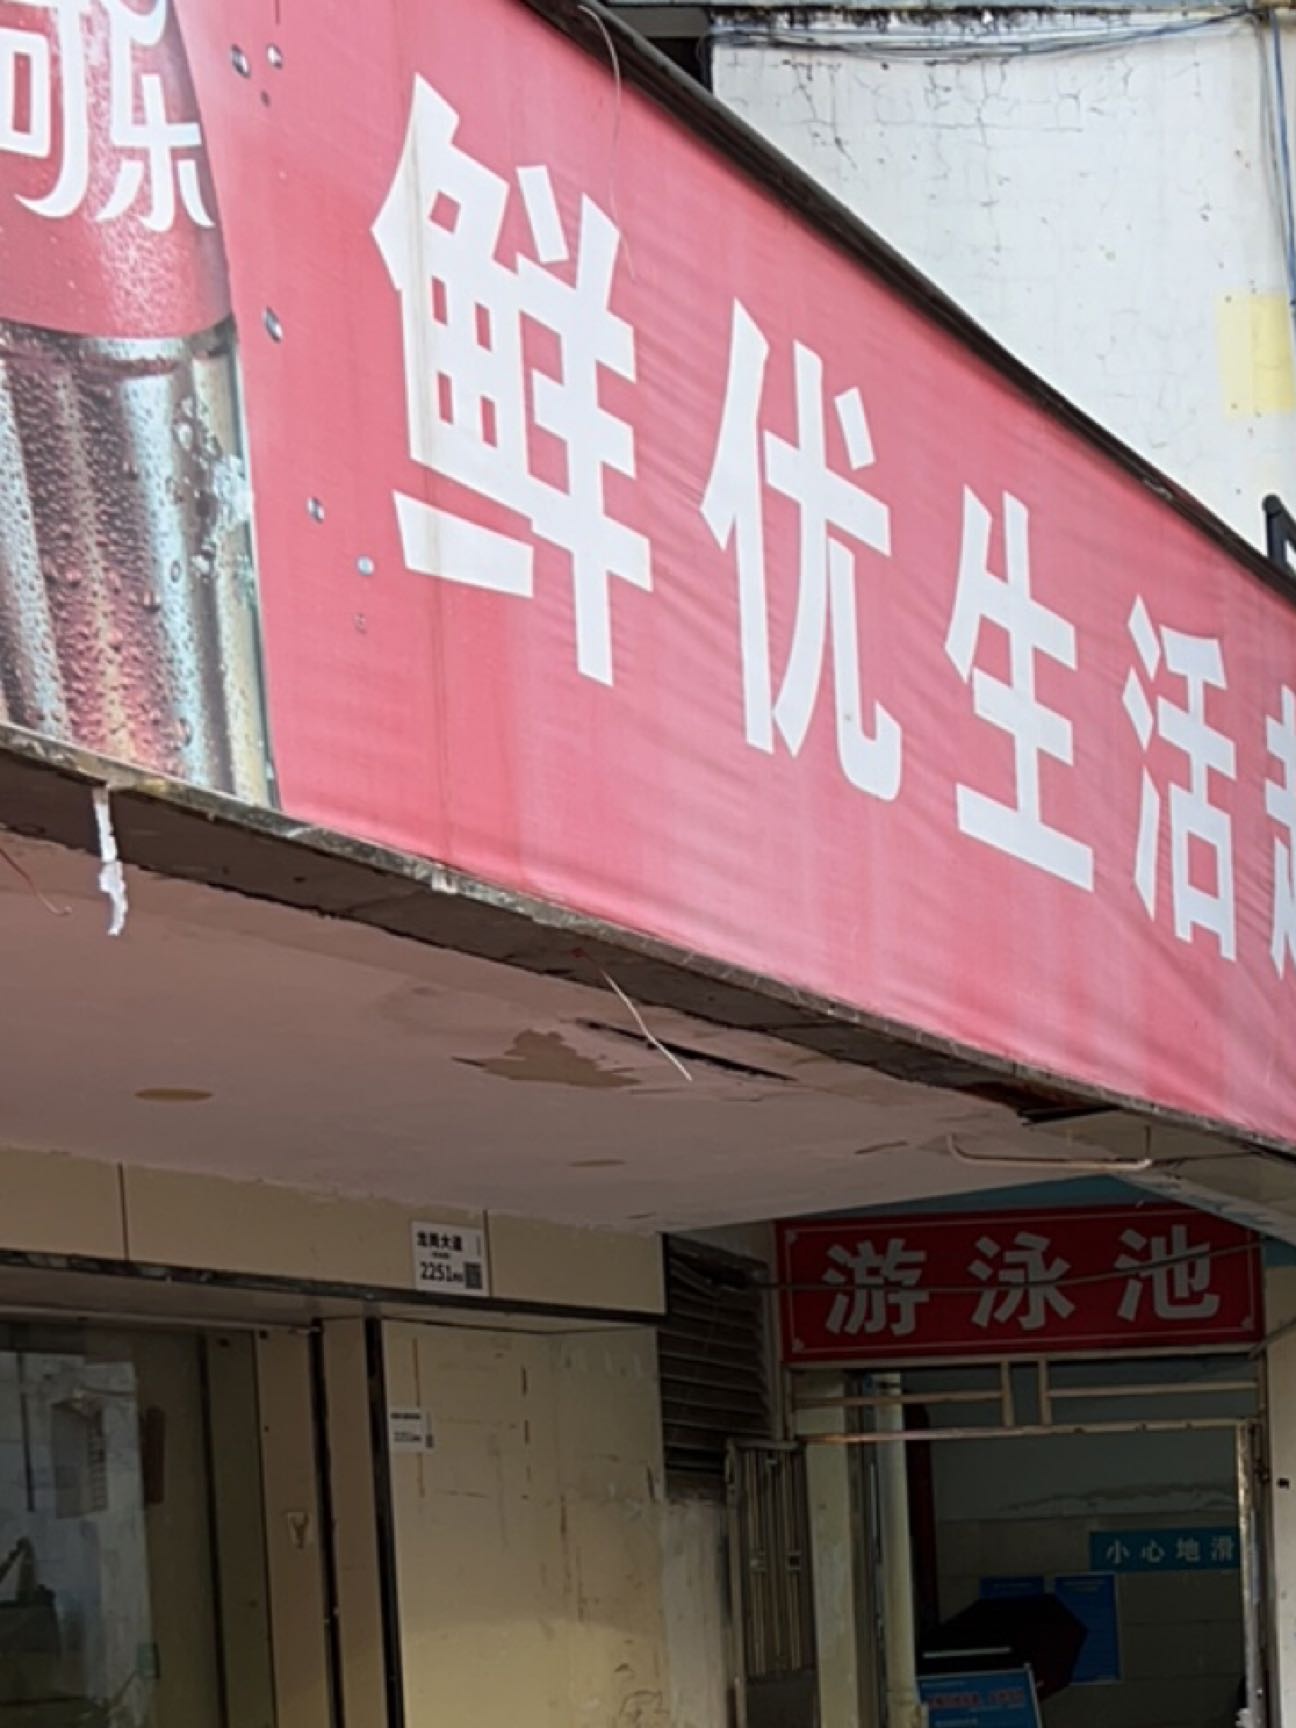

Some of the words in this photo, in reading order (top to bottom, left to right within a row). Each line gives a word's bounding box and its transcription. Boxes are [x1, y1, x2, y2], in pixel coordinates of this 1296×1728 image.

[822, 1225, 1220, 1336] 游泳池
[1105, 1535, 1236, 1564] 小心地滑
